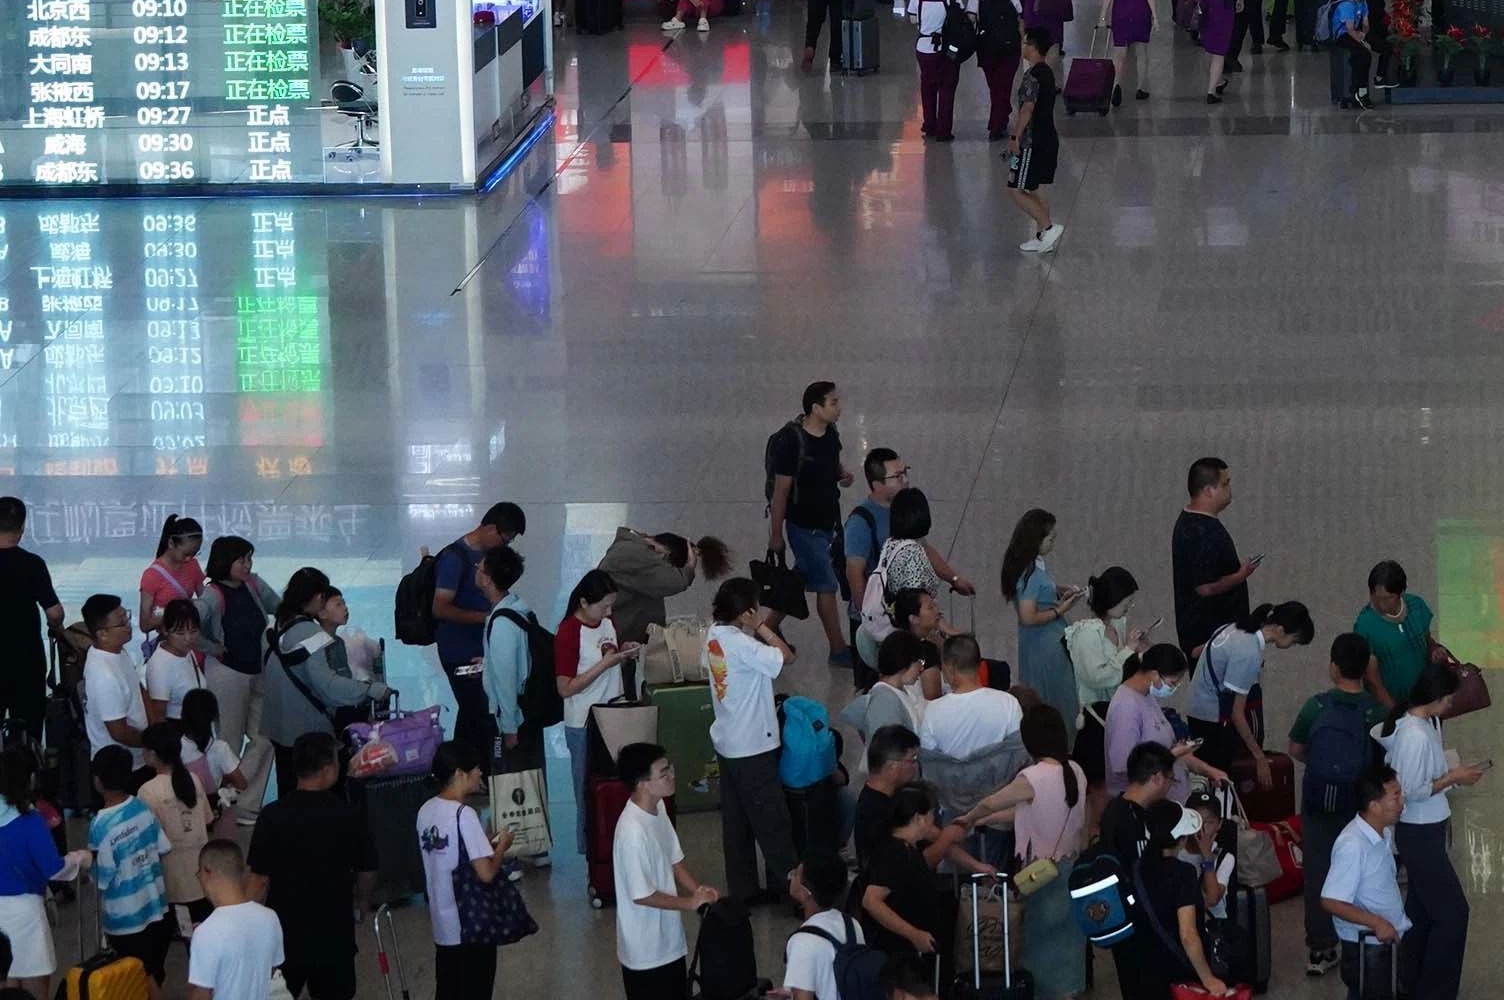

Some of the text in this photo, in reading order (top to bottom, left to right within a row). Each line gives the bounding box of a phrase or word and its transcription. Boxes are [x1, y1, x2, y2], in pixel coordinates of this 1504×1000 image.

[26, 0, 91, 21] 北京西
[132, 0, 187, 18] 09:10
[28, 23, 308, 49] 成都东 09:12 正在检票
[29, 50, 310, 75] 大同南 09:13 正在检票
[31, 78, 311, 103] 张掖西 09:17 正在检票
[22, 104, 290, 129] 上海虹桥 09:27 正点
[44, 131, 292, 155] 威海 09:30 正点
[35, 158, 293, 183] 成都东 09:36 正点
